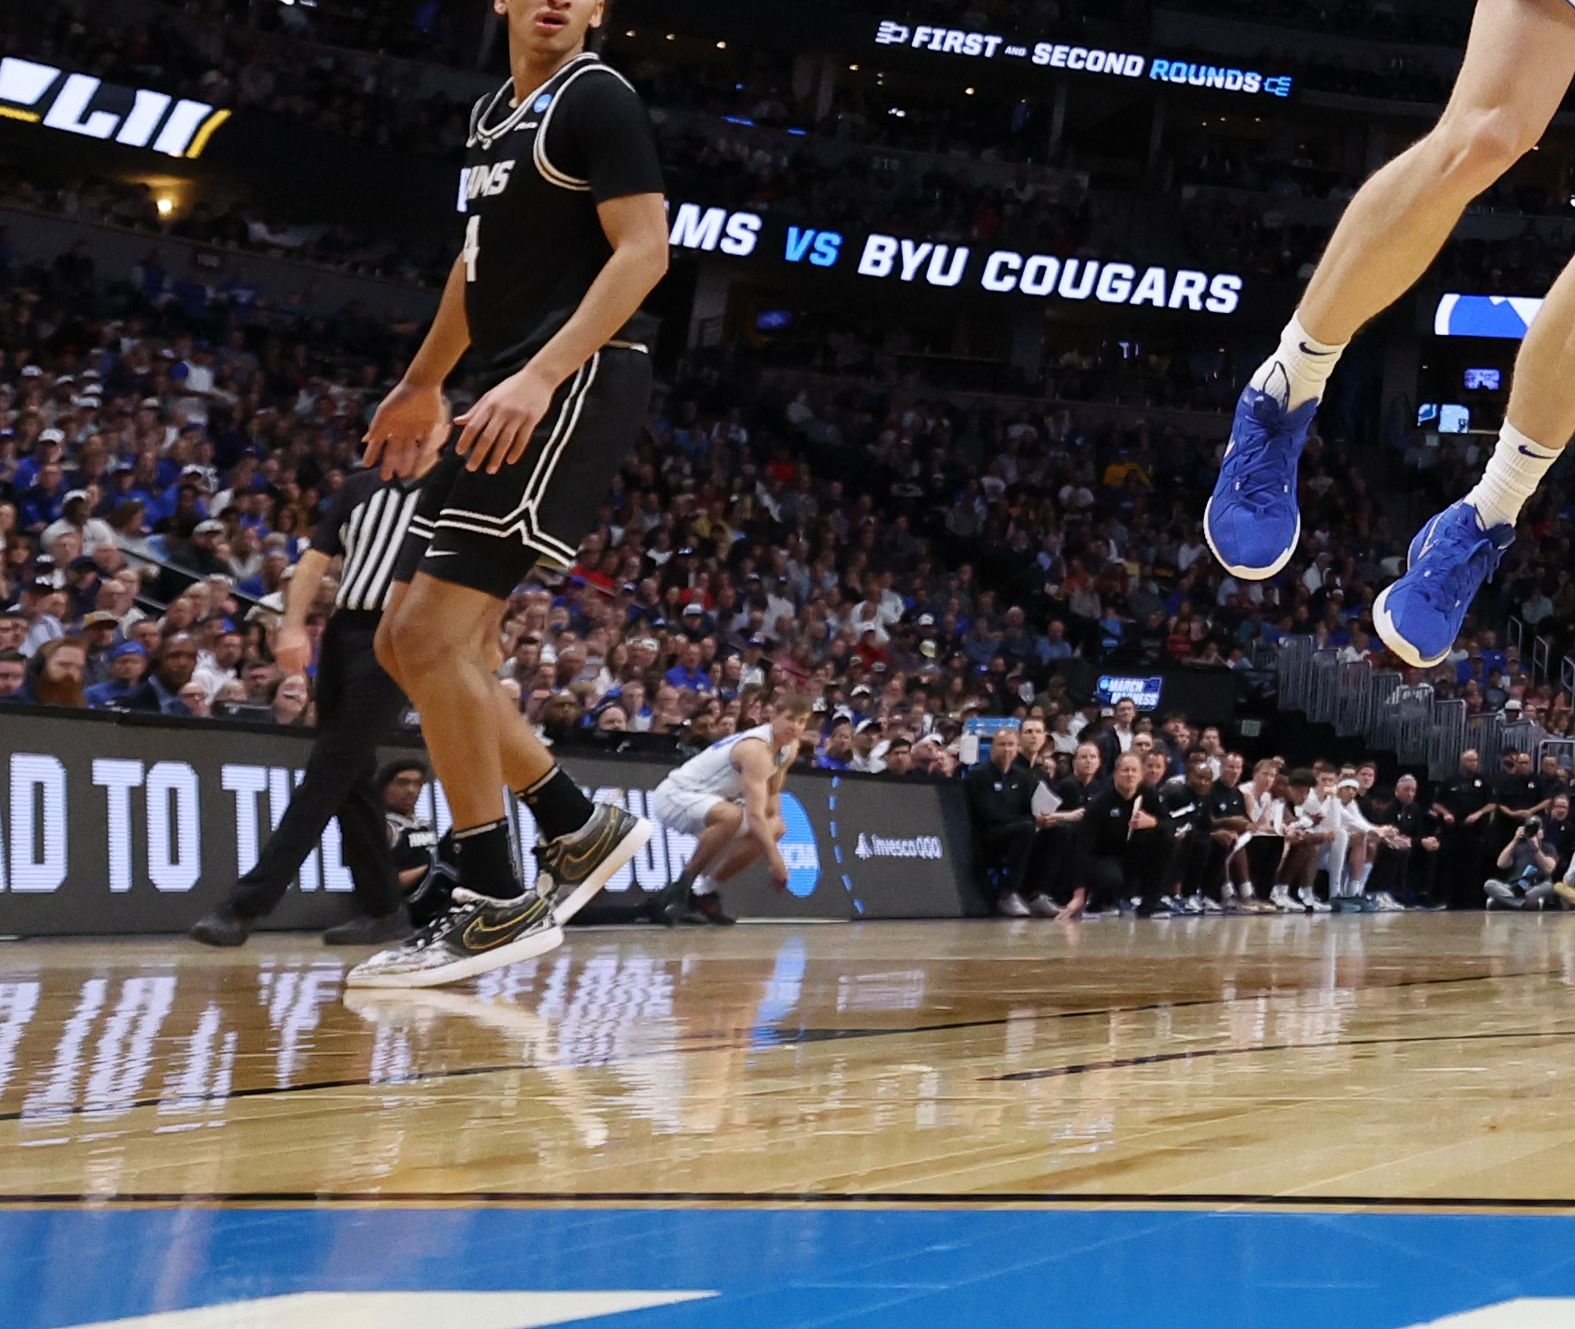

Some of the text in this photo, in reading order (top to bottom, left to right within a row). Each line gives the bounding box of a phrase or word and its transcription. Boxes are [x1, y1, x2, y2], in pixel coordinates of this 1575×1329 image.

[912, 26, 1003, 59] FIRST
[1031, 42, 1146, 78] SECOND
[1148, 58, 1263, 94] ROUNDS
[784, 225, 843, 268] VS
[858, 234, 970, 288] BYU
[981, 249, 1244, 315] COUGARS
[92, 759, 199, 893] TO
